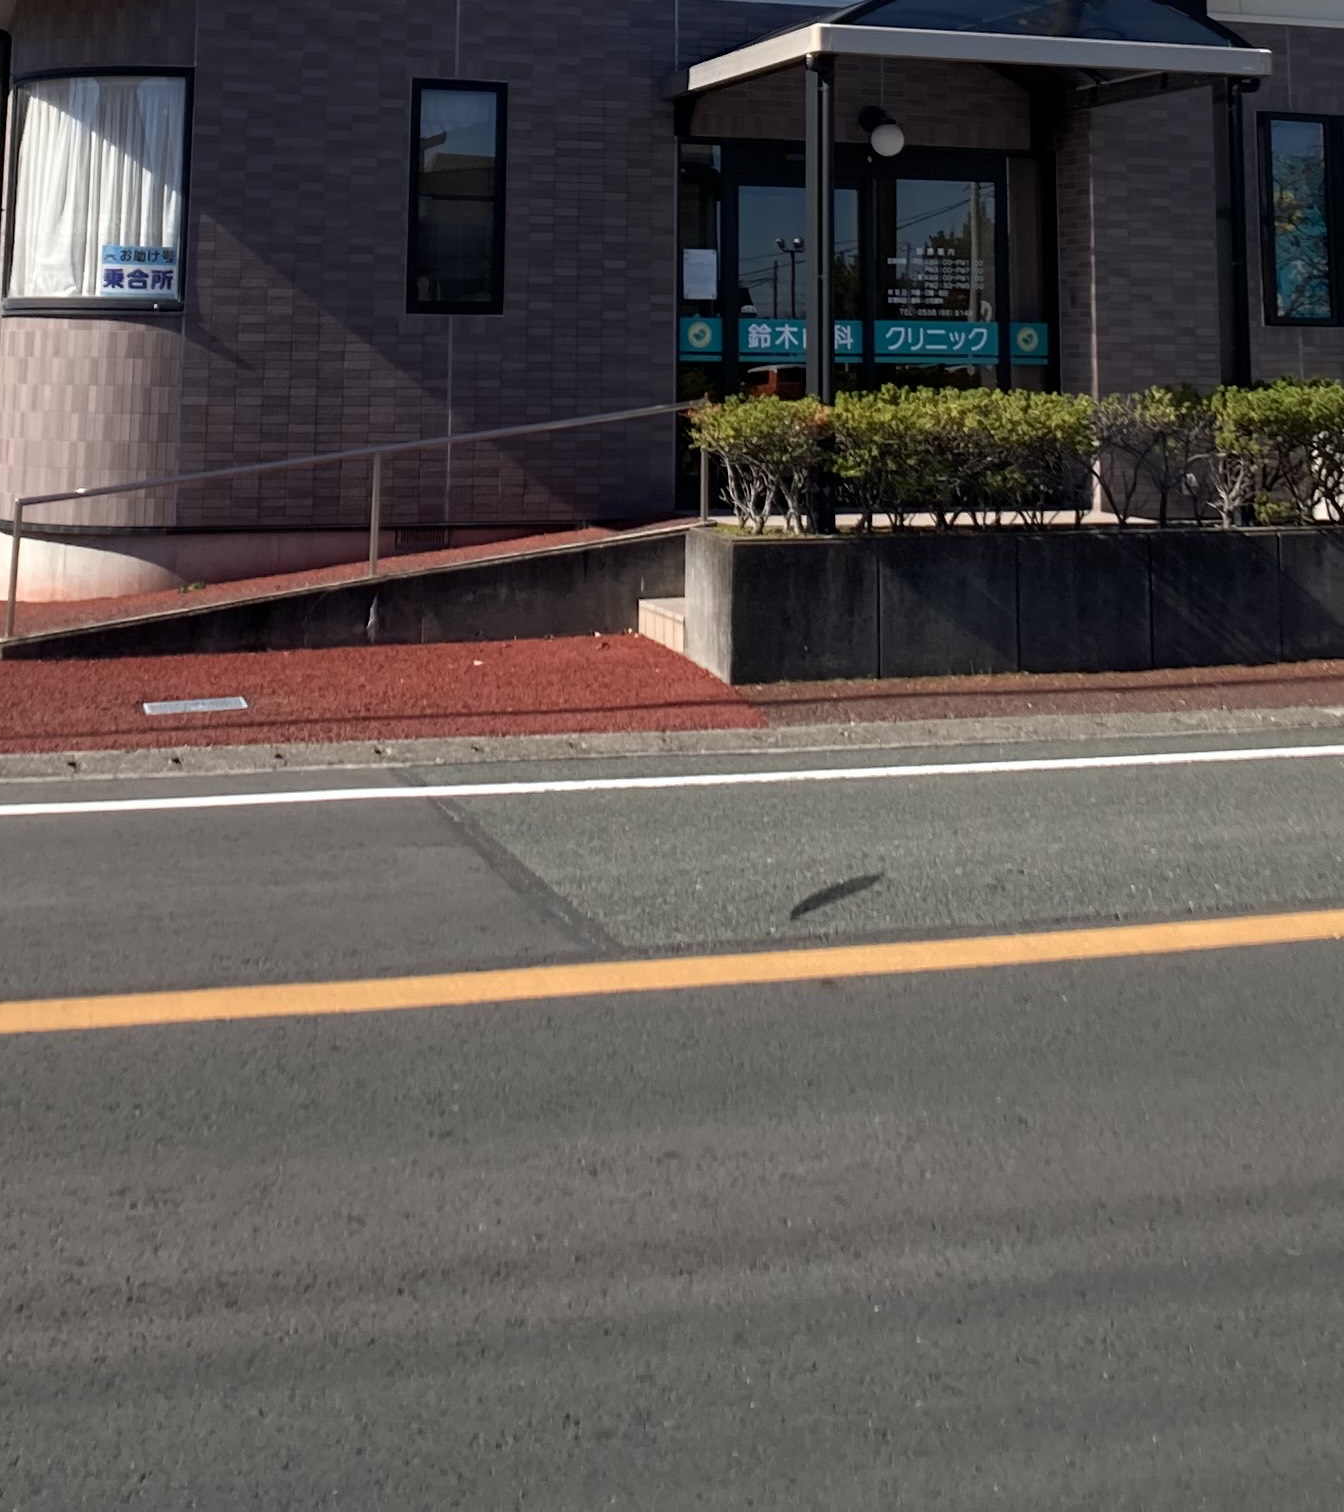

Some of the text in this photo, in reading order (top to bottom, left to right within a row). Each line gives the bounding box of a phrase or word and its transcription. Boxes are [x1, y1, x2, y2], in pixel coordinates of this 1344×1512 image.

[102, 268, 174, 290] 乗合所
[747, 323, 988, 351] 鈴木科 クリニック
